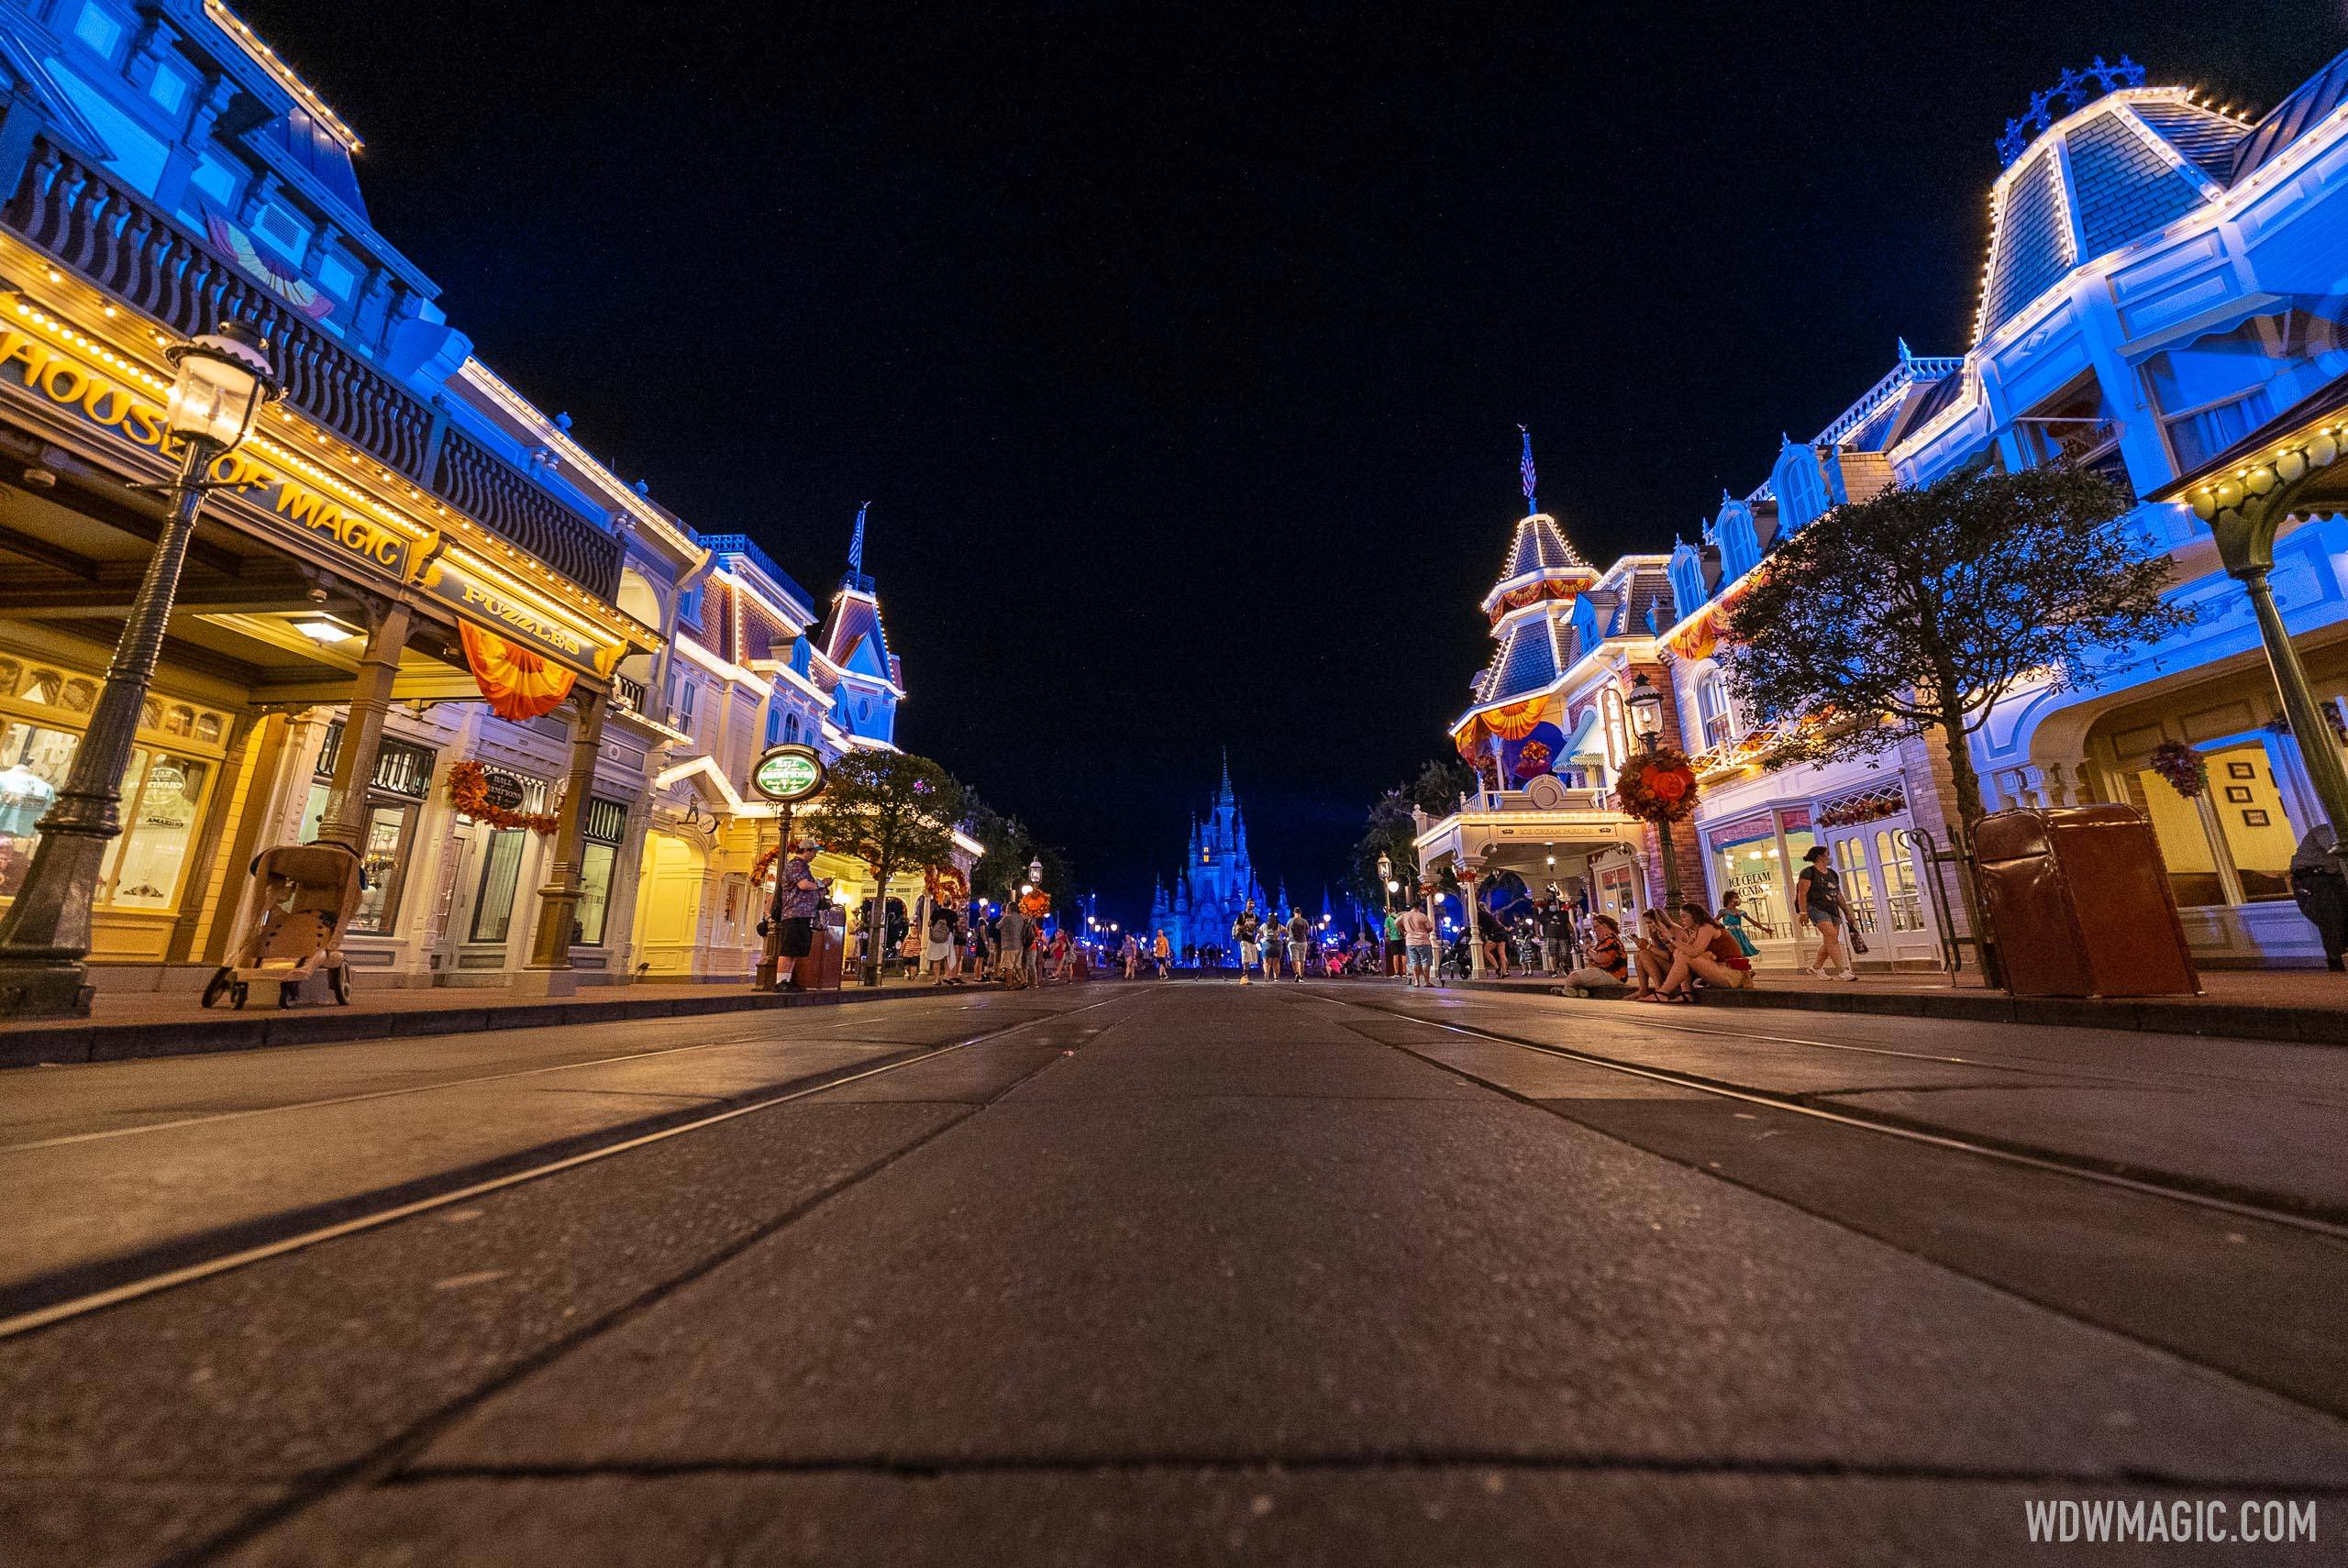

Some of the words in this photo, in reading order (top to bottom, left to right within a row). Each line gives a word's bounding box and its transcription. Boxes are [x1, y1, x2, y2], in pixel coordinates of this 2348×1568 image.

[0, 332, 186, 463] HOUSE
[210, 449, 276, 494] OF
[277, 482, 402, 565] MAGIC
[462, 584, 580, 655] PUZZLES
[493, 776, 513, 787] HALL
[1728, 877, 1741, 888] ICE
[1742, 871, 1771, 885] CREAM
[1738, 885, 1764, 897] CONES
